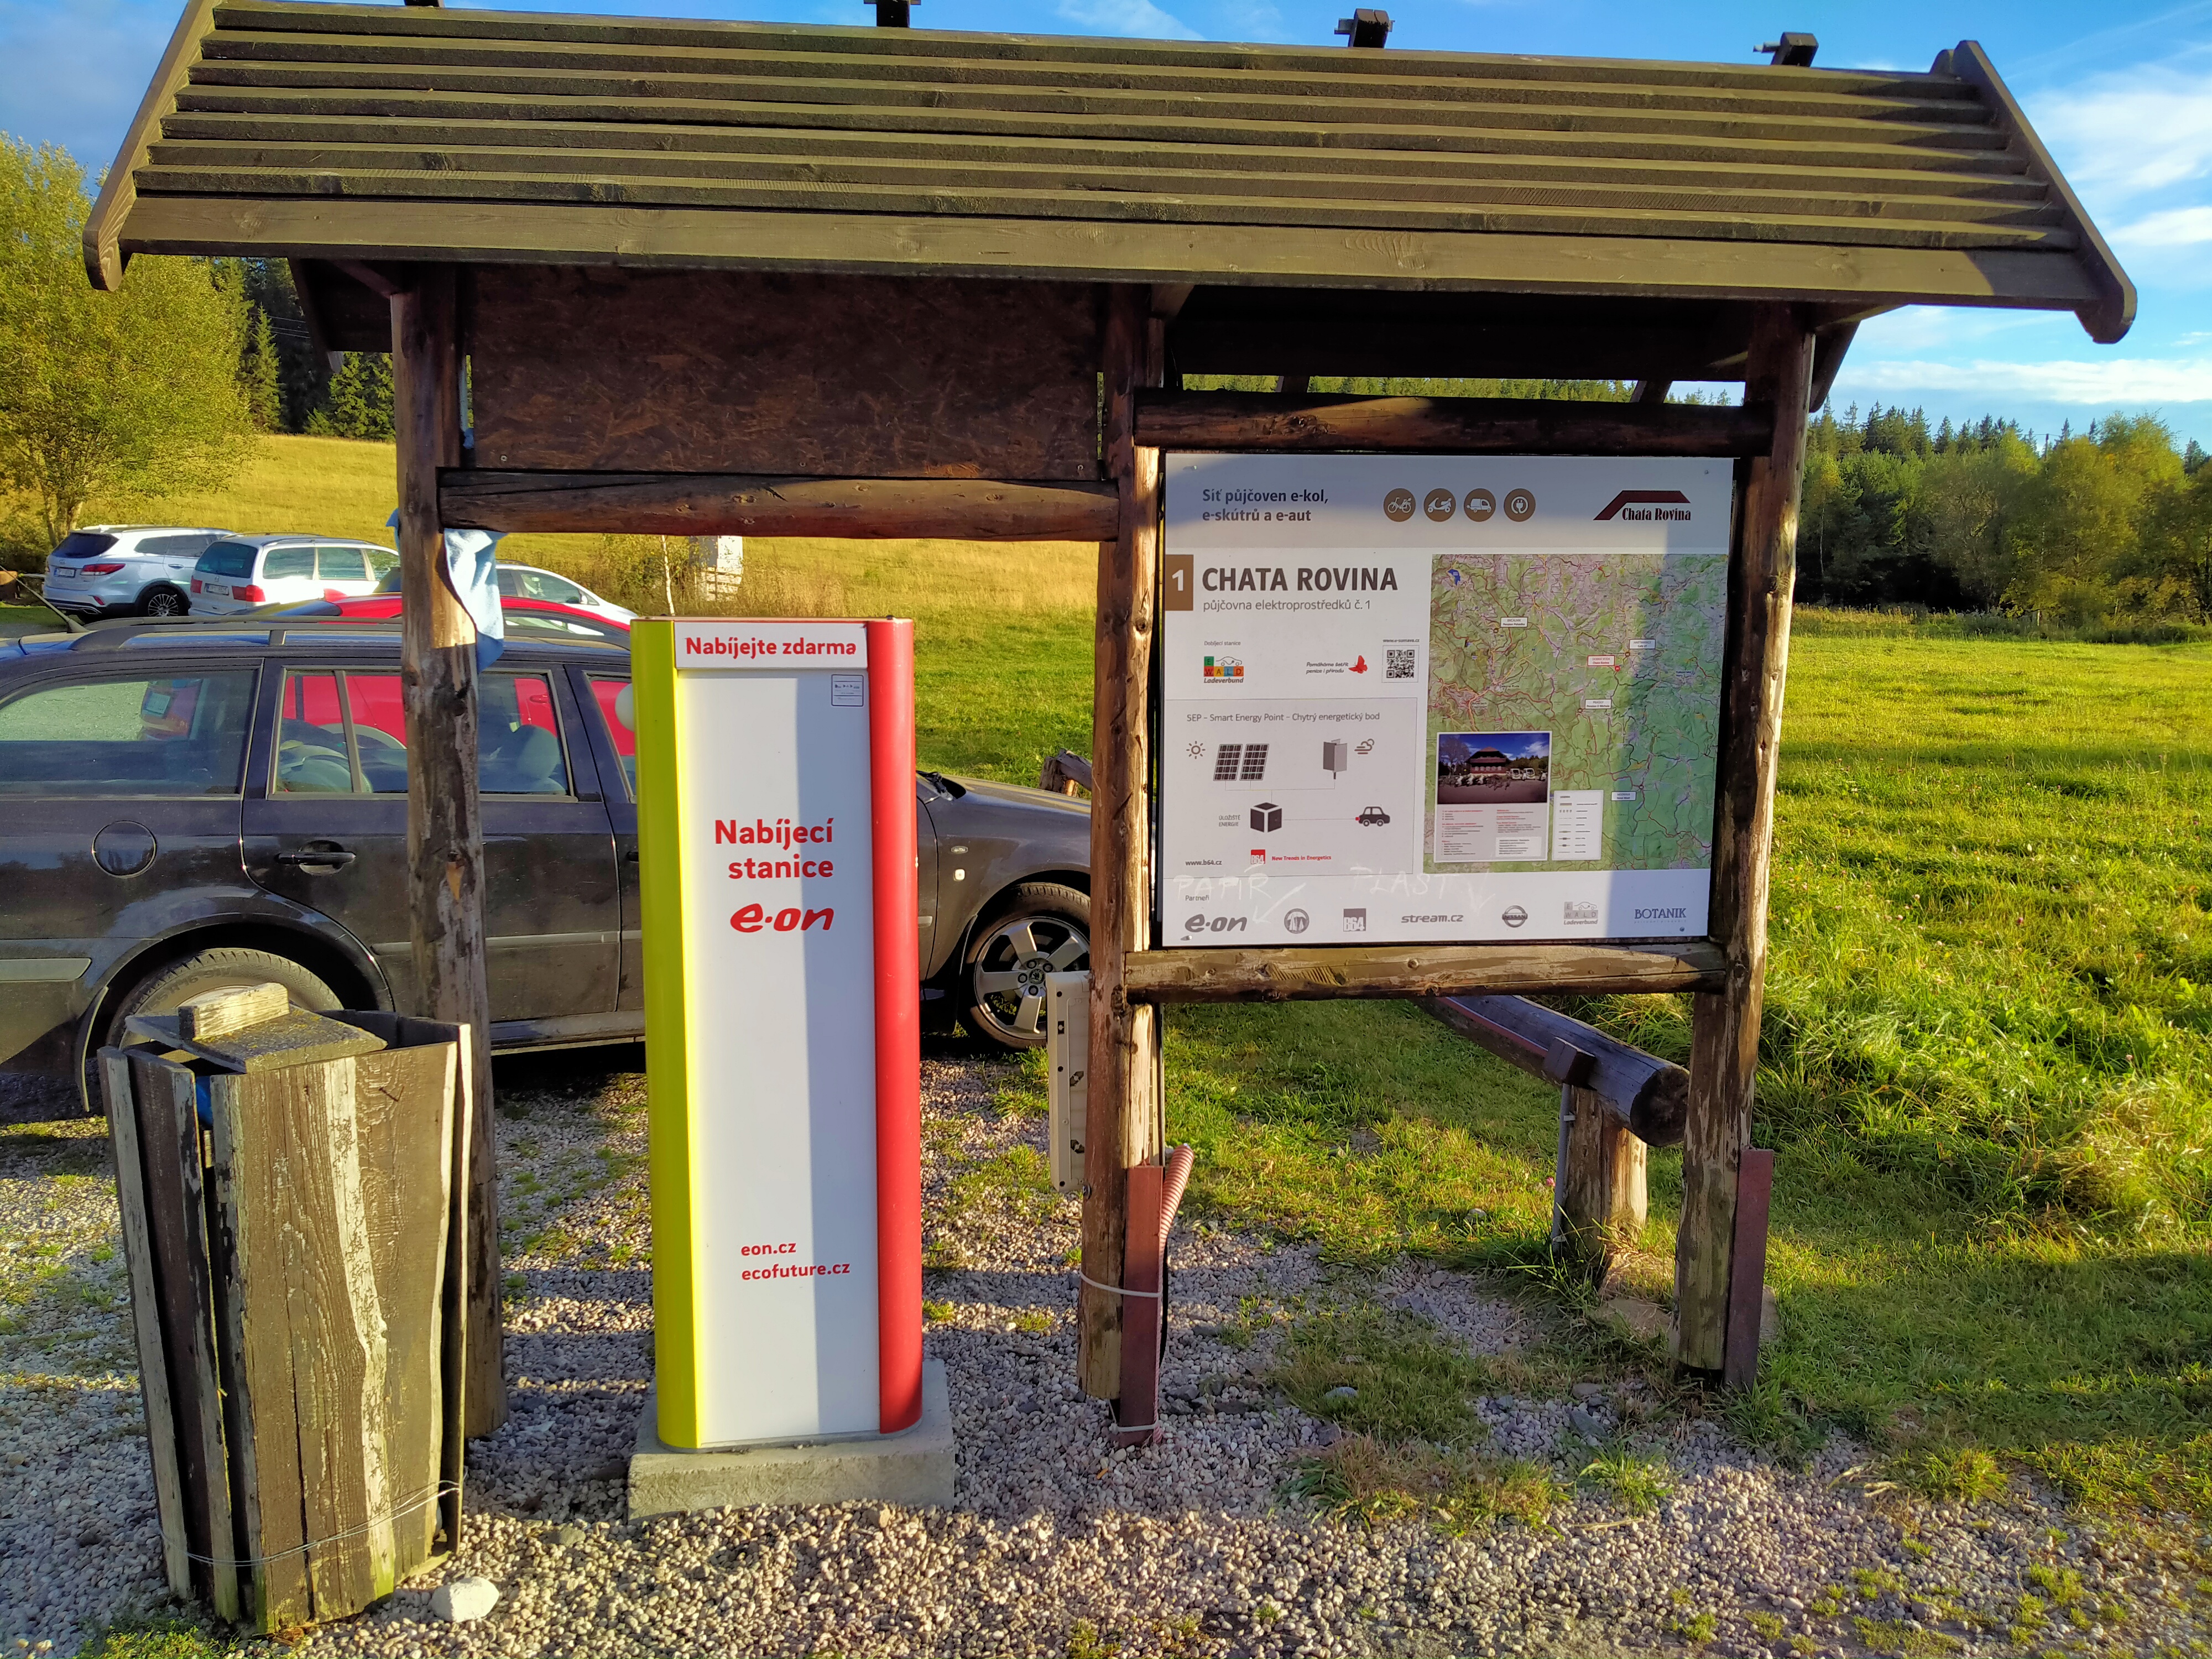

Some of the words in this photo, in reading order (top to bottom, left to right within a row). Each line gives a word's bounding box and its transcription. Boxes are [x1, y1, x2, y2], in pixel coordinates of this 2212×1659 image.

[1202, 488, 1222, 502] Síť
[1225, 488, 1287, 505] půjčoven
[1291, 488, 1328, 504] e-kol,
[1202, 508, 1260, 521] e-skútrů
[1264, 511, 1272, 521] a
[1276, 510, 1312, 521] e-aut
[1622, 507, 1652, 521] Chata
[1654, 507, 1691, 521] Rovina
[1172, 568, 1184, 592] 1
[1202, 567, 1288, 592] CHATA
[1297, 567, 1399, 591] ROVINA
[1203, 599, 1253, 613] půjčovna
[1255, 598, 1352, 612] elektroprostředků
[686, 637, 777, 660] Nabíjejte
[782, 637, 857, 655] zdarma
[1186, 713, 1202, 722] SEP
[1209, 713, 1234, 722] Smart
[1235, 713, 1262, 723] Energy
[1264, 713, 1284, 721] Point
[1292, 713, 1317, 722] Chytrý
[1318, 712, 1364, 722] energetický
[1365, 712, 1380, 721] bod
[715, 817, 834, 851] Nabíjecí
[728, 853, 834, 880] stanice
[1401, 914, 1464, 924] stream.cz
[1634, 907, 1687, 920] BOTANIK
[1344, 916, 1365, 932] B64
[740, 1243, 797, 1256] eon.cz
[741, 1262, 851, 1281] ecofuture.cz
